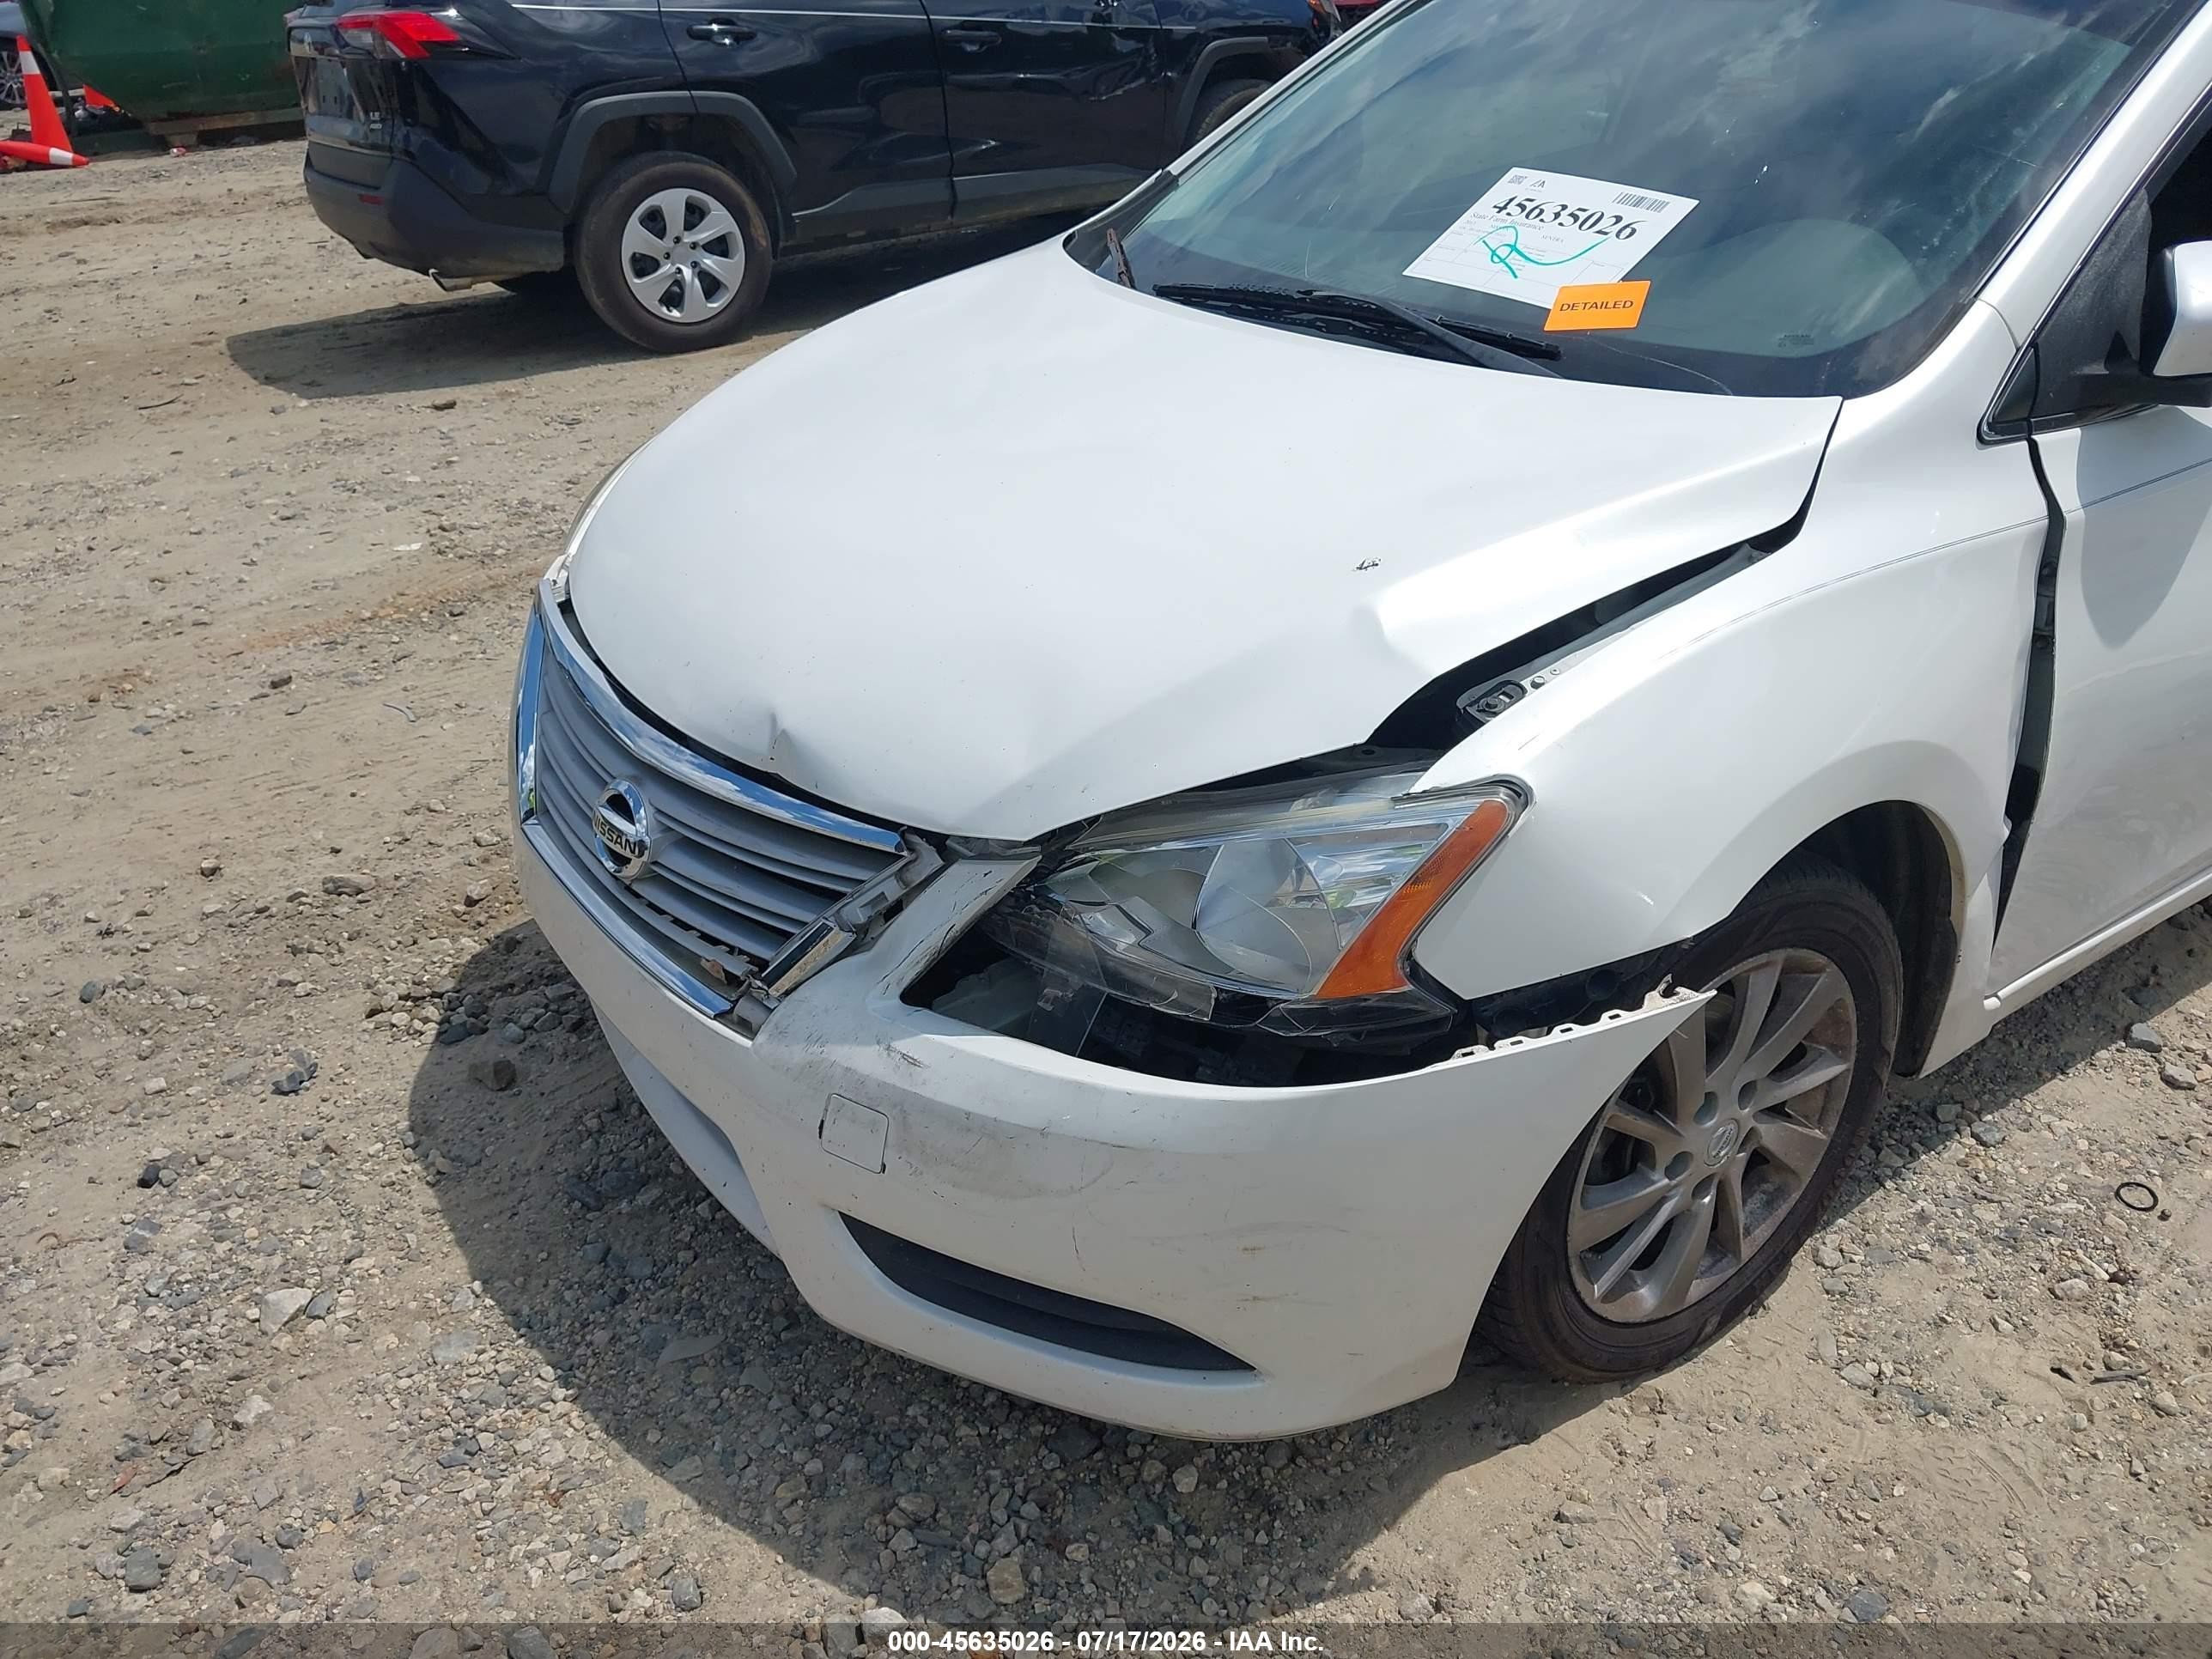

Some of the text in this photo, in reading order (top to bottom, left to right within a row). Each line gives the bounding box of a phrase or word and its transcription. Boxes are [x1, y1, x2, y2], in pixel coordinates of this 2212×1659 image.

[1489, 214, 1508, 224] Farm
[1509, 218, 1545, 231] Insurance
[1492, 195, 1649, 240] 45635026
[1559, 300, 1634, 312] DETAILED
[592, 811, 636, 854] NISSAN
